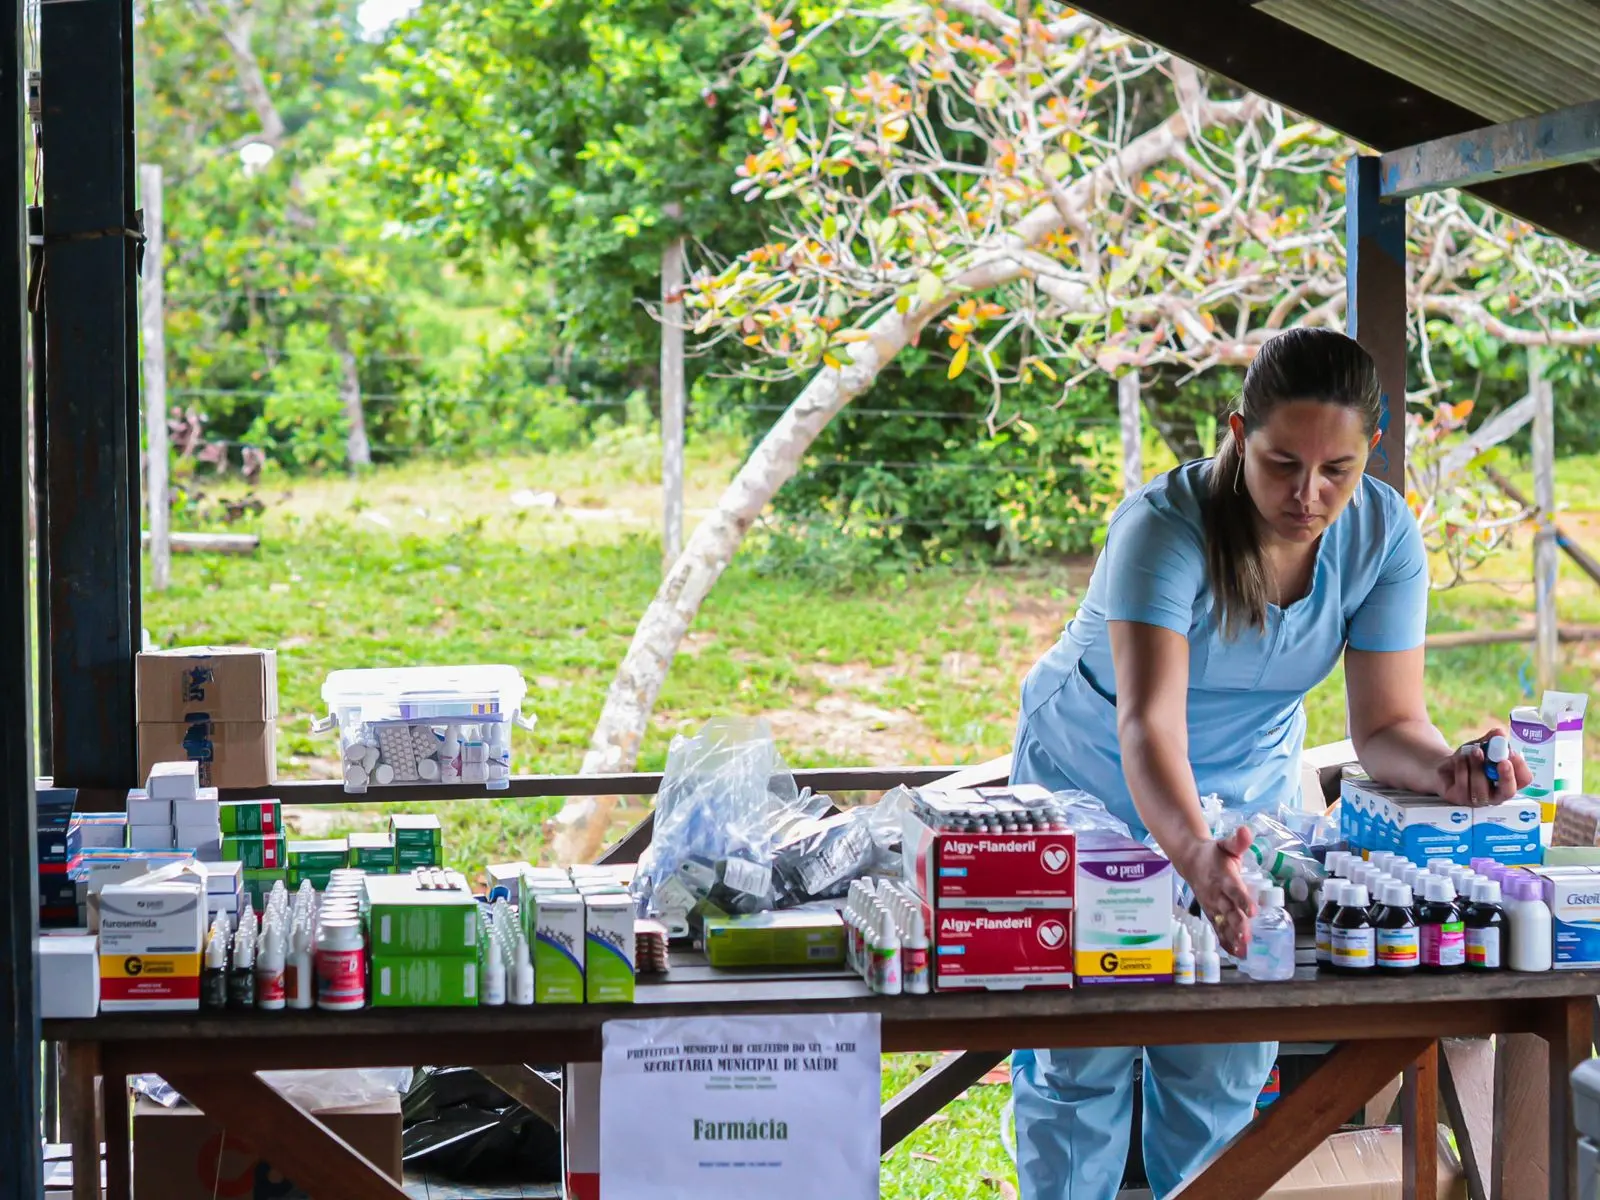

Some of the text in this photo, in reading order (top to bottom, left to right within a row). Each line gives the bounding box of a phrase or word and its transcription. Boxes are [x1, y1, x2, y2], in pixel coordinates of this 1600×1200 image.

[943, 840, 1036, 854] Algy-Flanderil
[1120, 863, 1145, 878] prati
[102, 919, 157, 928] furosemida
[941, 917, 1032, 931] Algy-Flanderil
[124, 956, 142, 976] G
[1100, 952, 1118, 972] G
[627, 1045, 680, 1059] PREFEITURA
[683, 1044, 729, 1055] MUNICIPAL
[732, 1044, 743, 1054] DE
[792, 1043, 805, 1052] DO
[834, 1042, 856, 1052] ACRE
[643, 1056, 838, 1073] SECRETARIA MUNICIPAL DE SAÚDE
[693, 1117, 788, 1141] Farmácia
